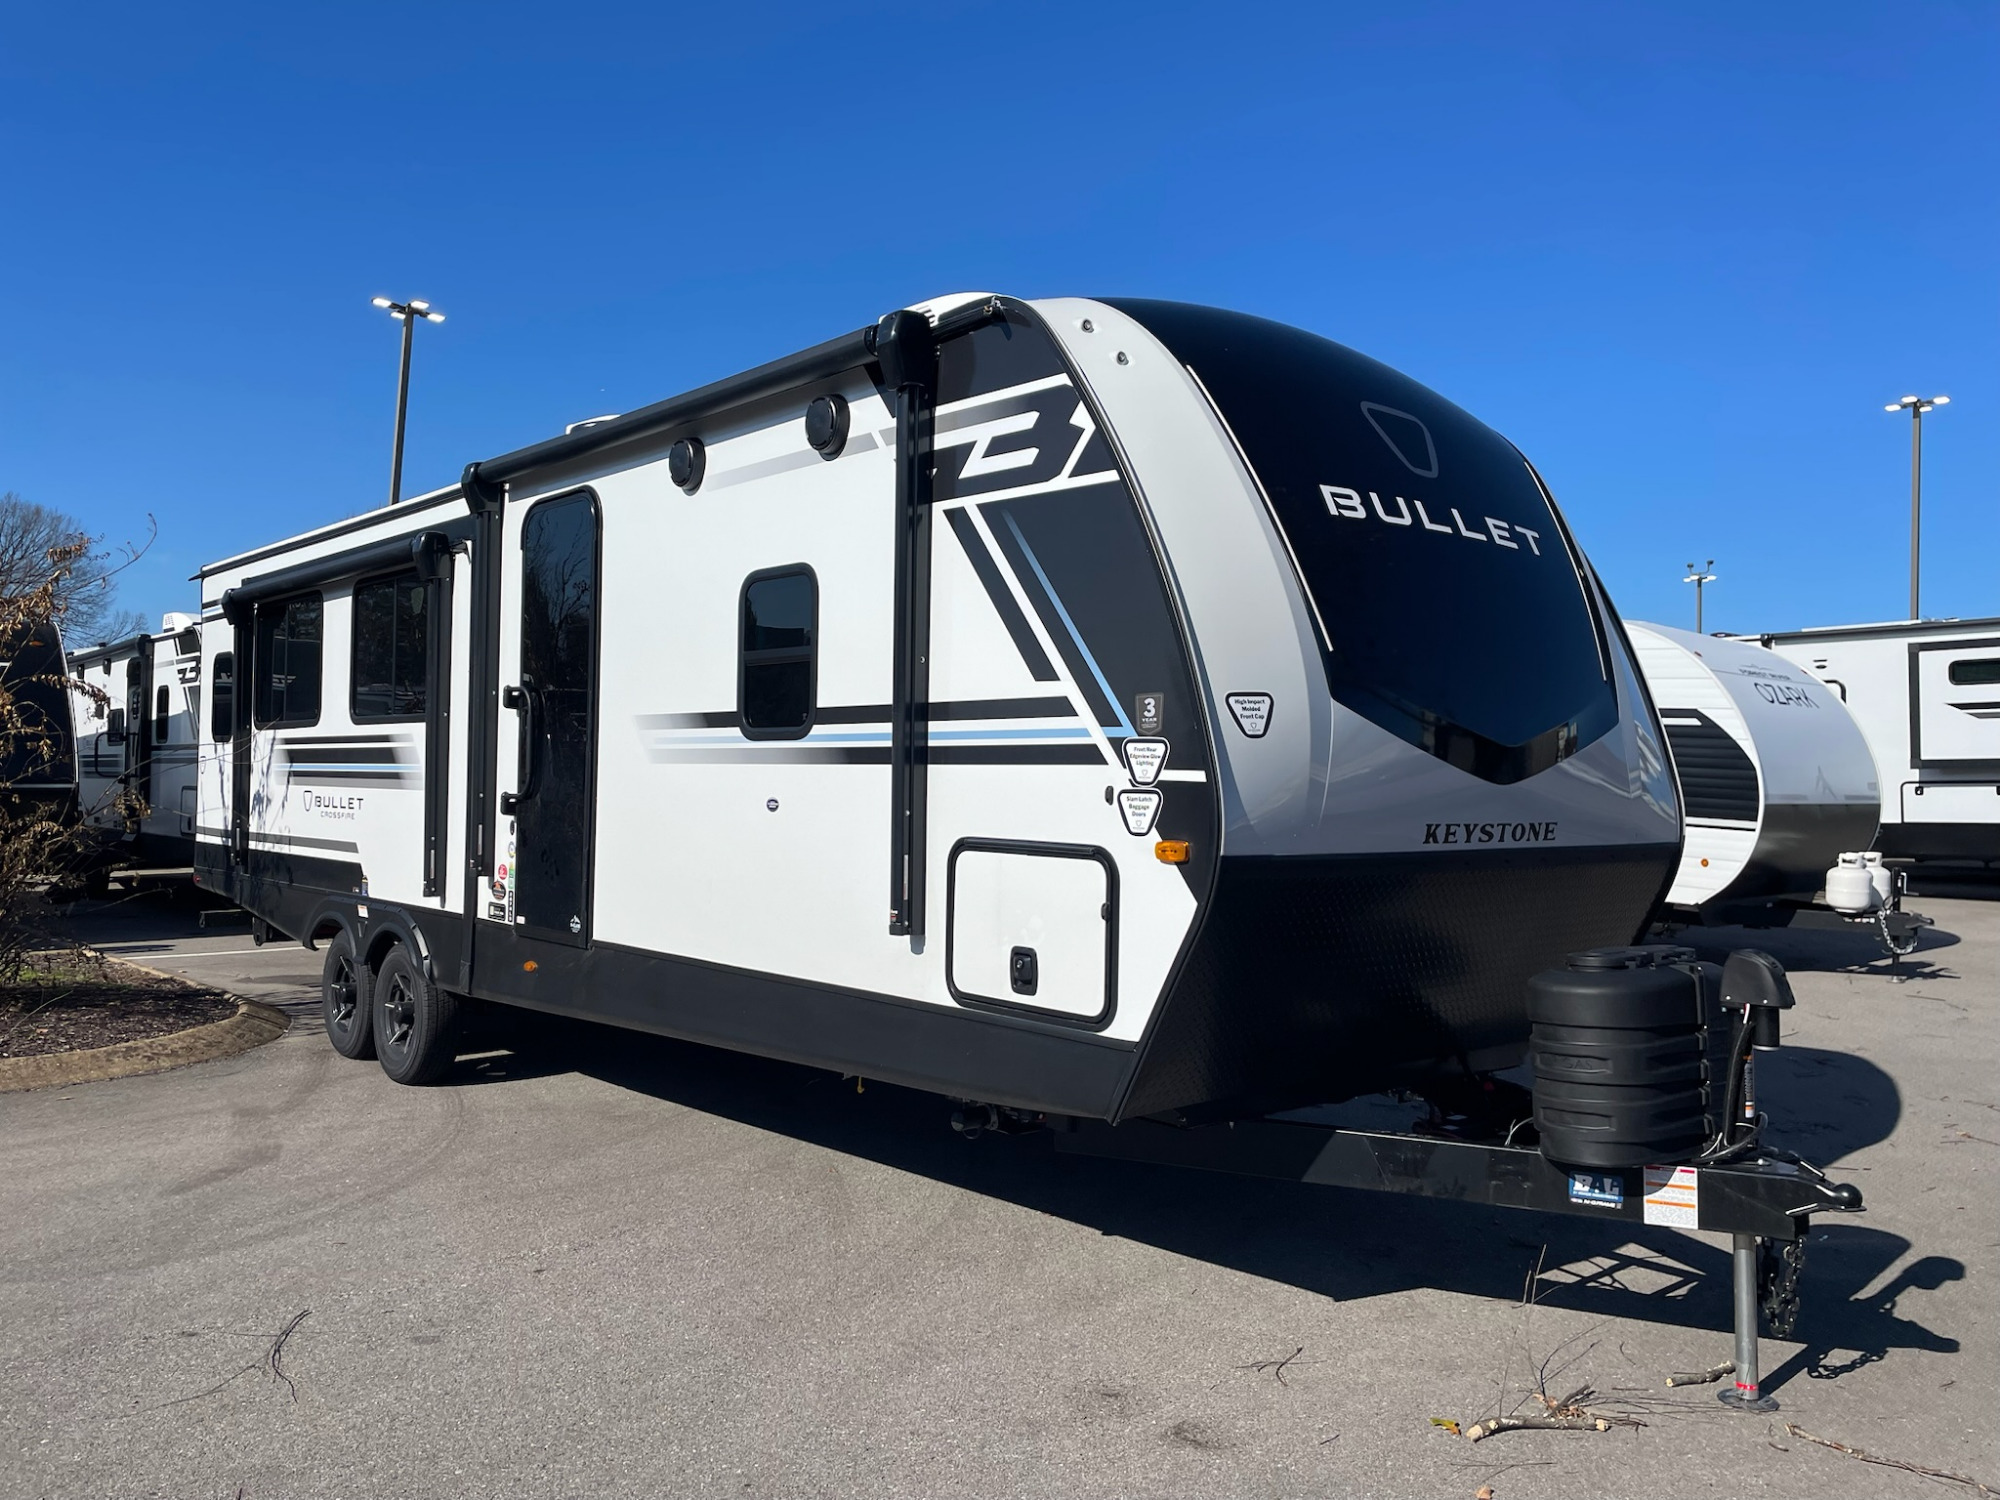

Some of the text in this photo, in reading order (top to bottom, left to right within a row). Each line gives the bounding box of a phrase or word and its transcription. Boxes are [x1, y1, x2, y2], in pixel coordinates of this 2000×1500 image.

[1318, 484, 1541, 557] BULLET
[1753, 682, 1820, 709] OZARK
[1143, 697, 1156, 717] 3
[314, 795, 364, 810] BULLET
[320, 811, 355, 820] CROSSFIRE
[1422, 822, 1558, 845] KEYSTONE
